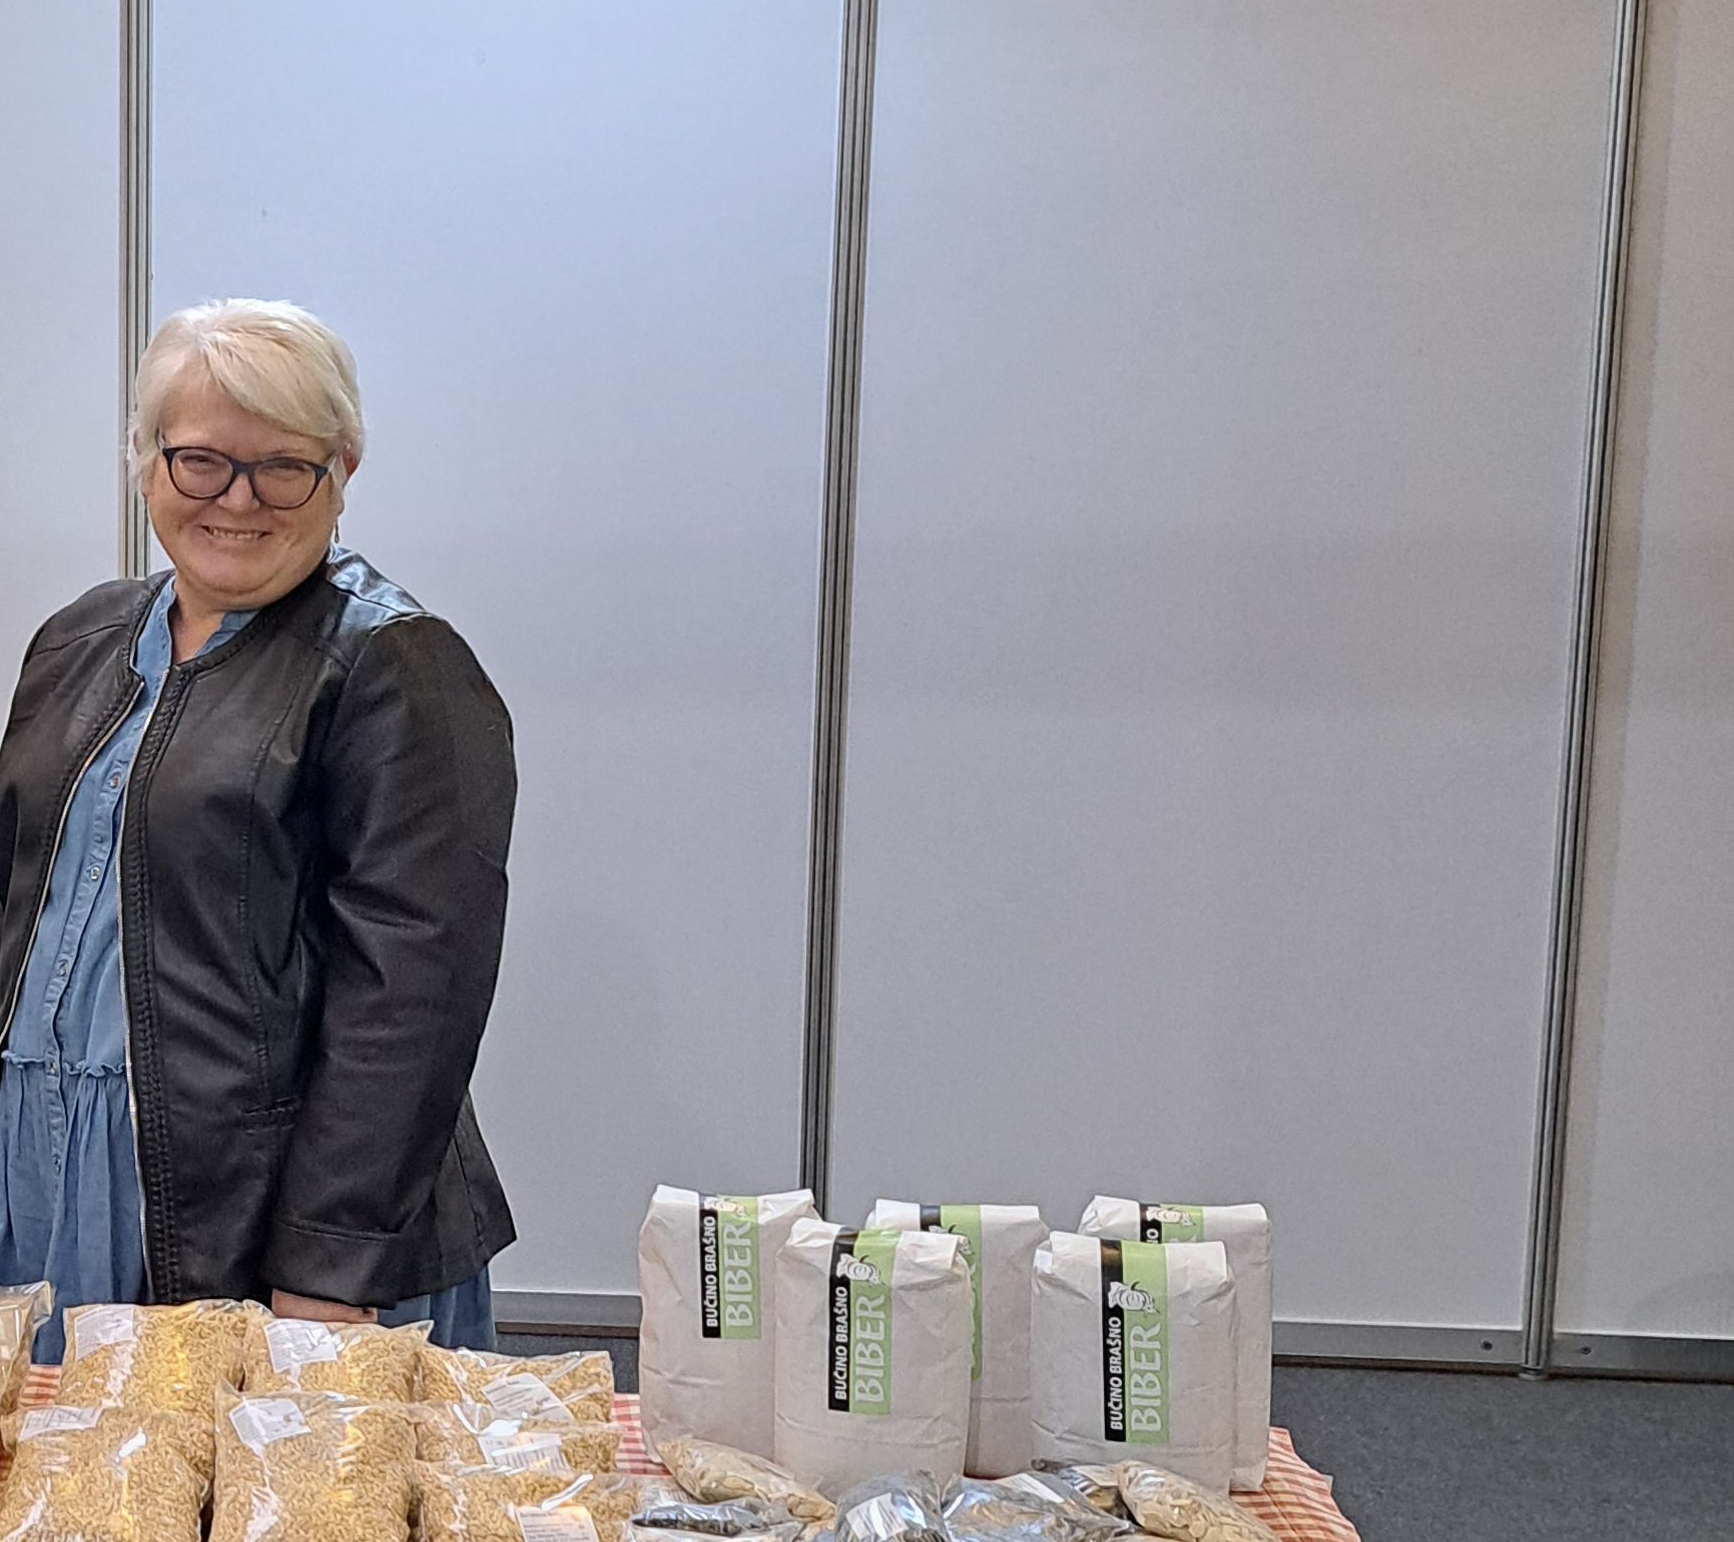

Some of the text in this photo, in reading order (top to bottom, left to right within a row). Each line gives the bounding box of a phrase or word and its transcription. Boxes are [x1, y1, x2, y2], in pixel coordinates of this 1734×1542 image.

[702, 1216, 718, 1327] BUČINO BRAŠNO
[723, 1221, 755, 1328] BIBER
[833, 1286, 848, 1400] BUČINO BRAŠNO
[855, 1293, 886, 1403] BIBER
[1106, 1316, 1123, 1430] BUČINO BRAŠNO
[1130, 1322, 1163, 1433] BIBER
